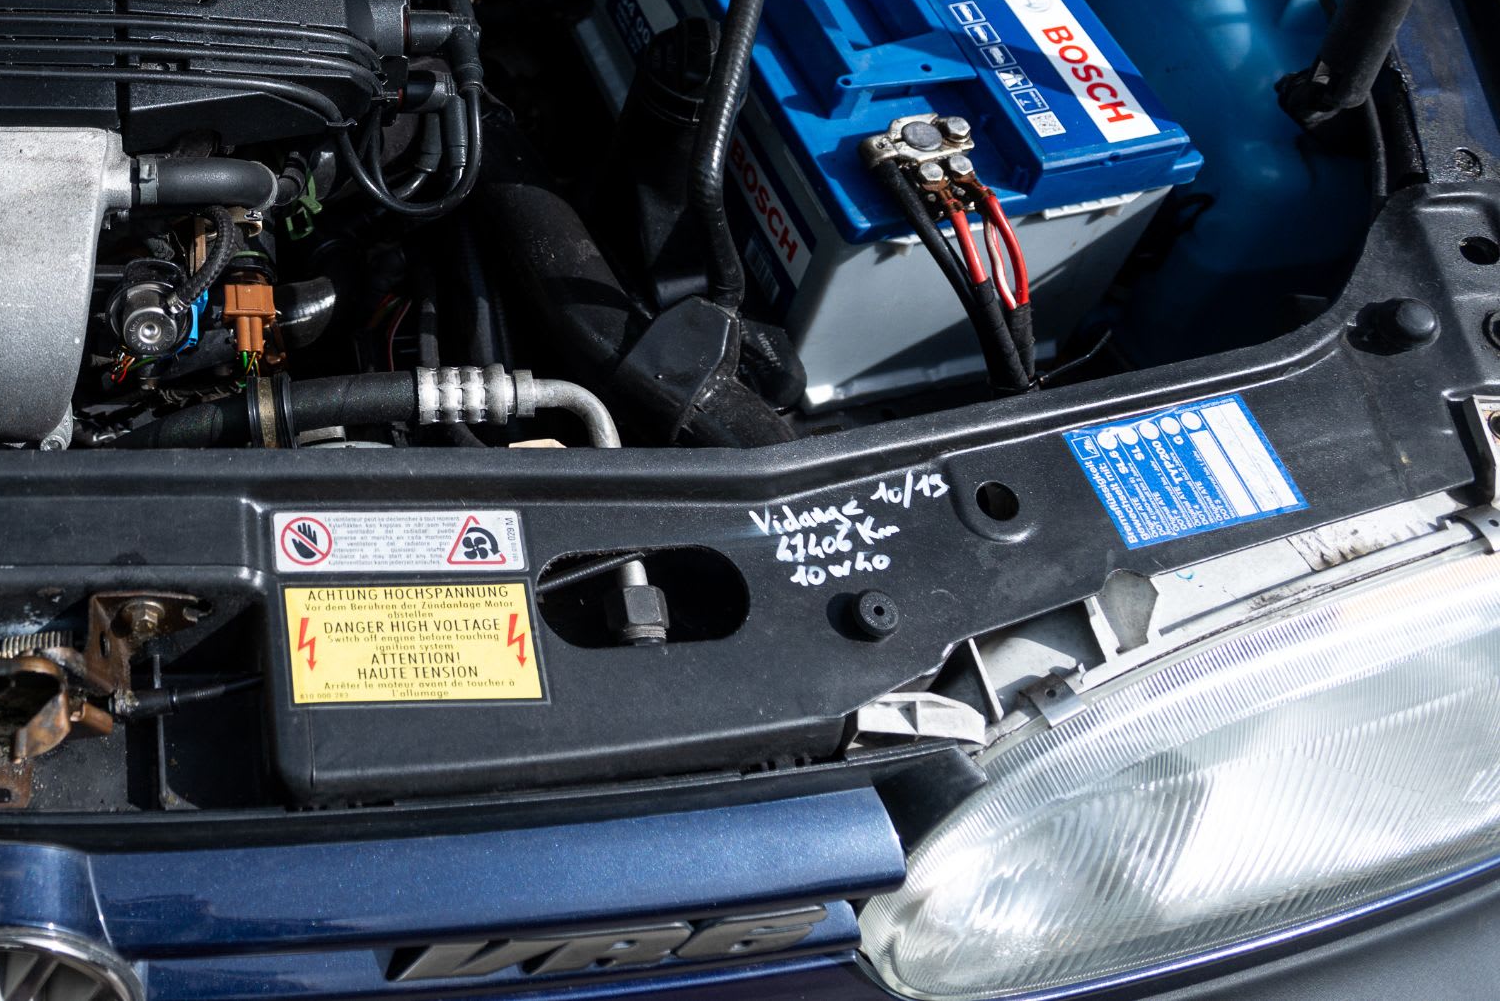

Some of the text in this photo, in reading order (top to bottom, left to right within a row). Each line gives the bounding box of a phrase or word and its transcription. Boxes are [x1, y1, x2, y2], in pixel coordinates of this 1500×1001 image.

[1041, 25, 1135, 123] BOSCH
[731, 138, 799, 264] BOSCH
[1173, 435, 1184, 445] G
[1131, 445, 1145, 461] SL
[1109, 450, 1129, 474] SL.6
[1152, 440, 1183, 484] TYP200
[1172, 486, 1186, 500] ATE
[1194, 481, 1208, 494] ATE
[1085, 461, 1138, 543] Bremsflüssigkeit
[1099, 462, 1150, 540] gewechselt mit:
[1131, 497, 1144, 511] ATE
[1152, 492, 1165, 505] ATE
[505, 517, 514, 525] M
[506, 527, 516, 540] 029
[308, 585, 508, 601] ACHTUNG HOCHSPANNUNG
[304, 603, 324, 611] Vor
[325, 603, 346, 611] dem
[400, 601, 416, 610] der
[484, 599, 514, 608] Motor
[388, 610, 434, 619] abstellen
[324, 619, 501, 634] DANGER HIGH VOLTAGE
[327, 632, 500, 644] Switch off engine before touching
[375, 643, 454, 652] ignition system
[370, 652, 462, 665] ATTENTION!
[357, 665, 478, 680] HAUTE TENSION
[364, 681, 374, 689] le
[377, 681, 414, 689] moteur
[418, 681, 448, 689] avant
[451, 679, 464, 688] de
[466, 679, 505, 687] toucher
[384, 903, 828, 983] VR6
